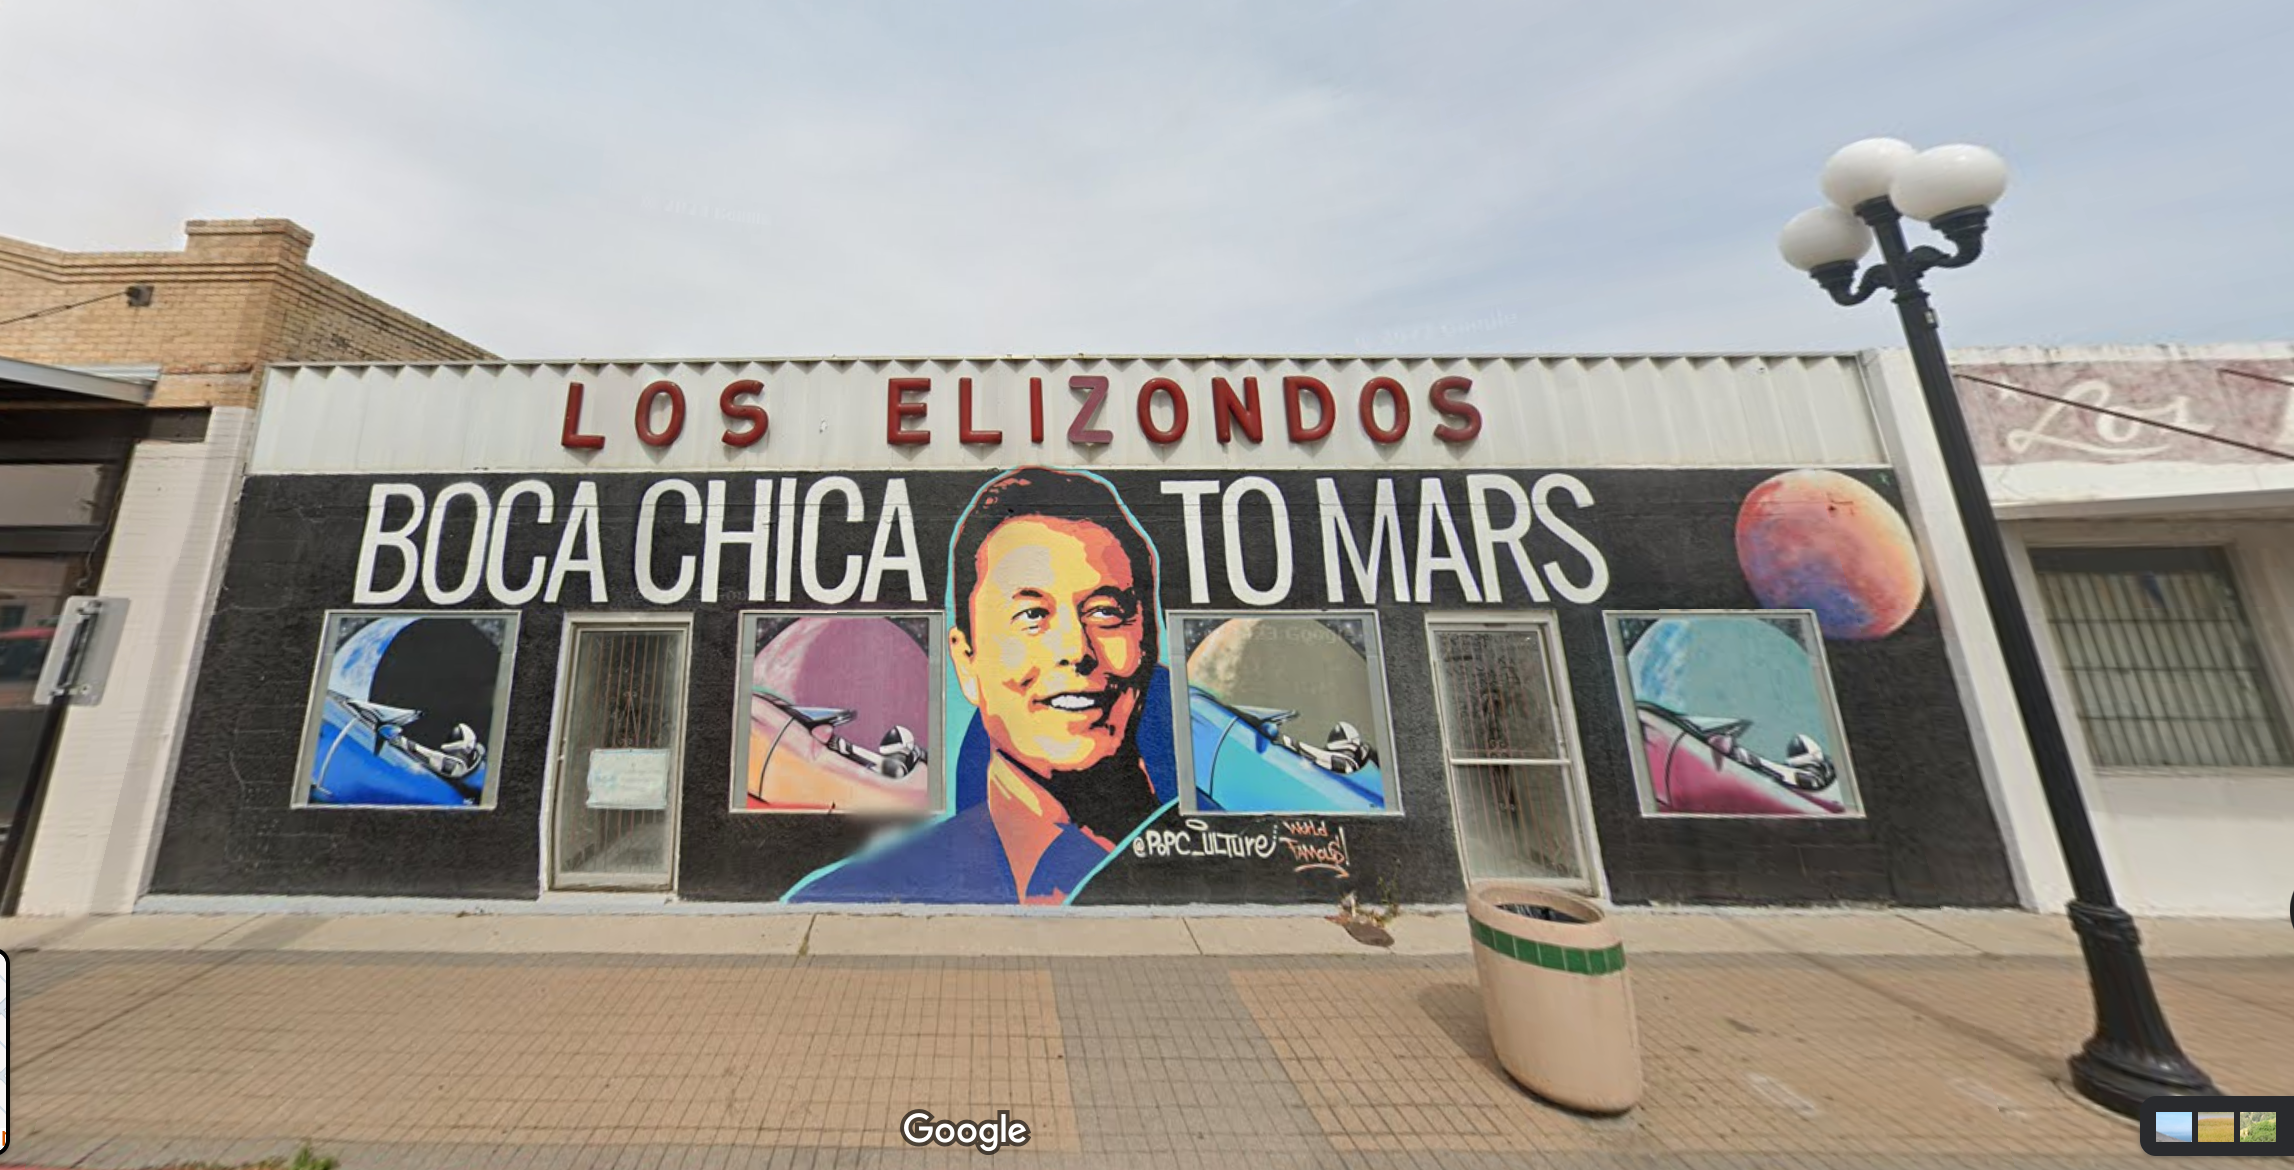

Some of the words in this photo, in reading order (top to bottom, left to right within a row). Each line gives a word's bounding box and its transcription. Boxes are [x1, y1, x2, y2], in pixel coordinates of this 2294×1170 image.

[561, 379, 769, 449] LOS
[887, 375, 1483, 444] ELIZONDOS
[353, 479, 608, 605] BOCA
[634, 476, 928, 604] CHICA
[1160, 476, 1294, 605] TO
[1315, 473, 1610, 605] MARS
